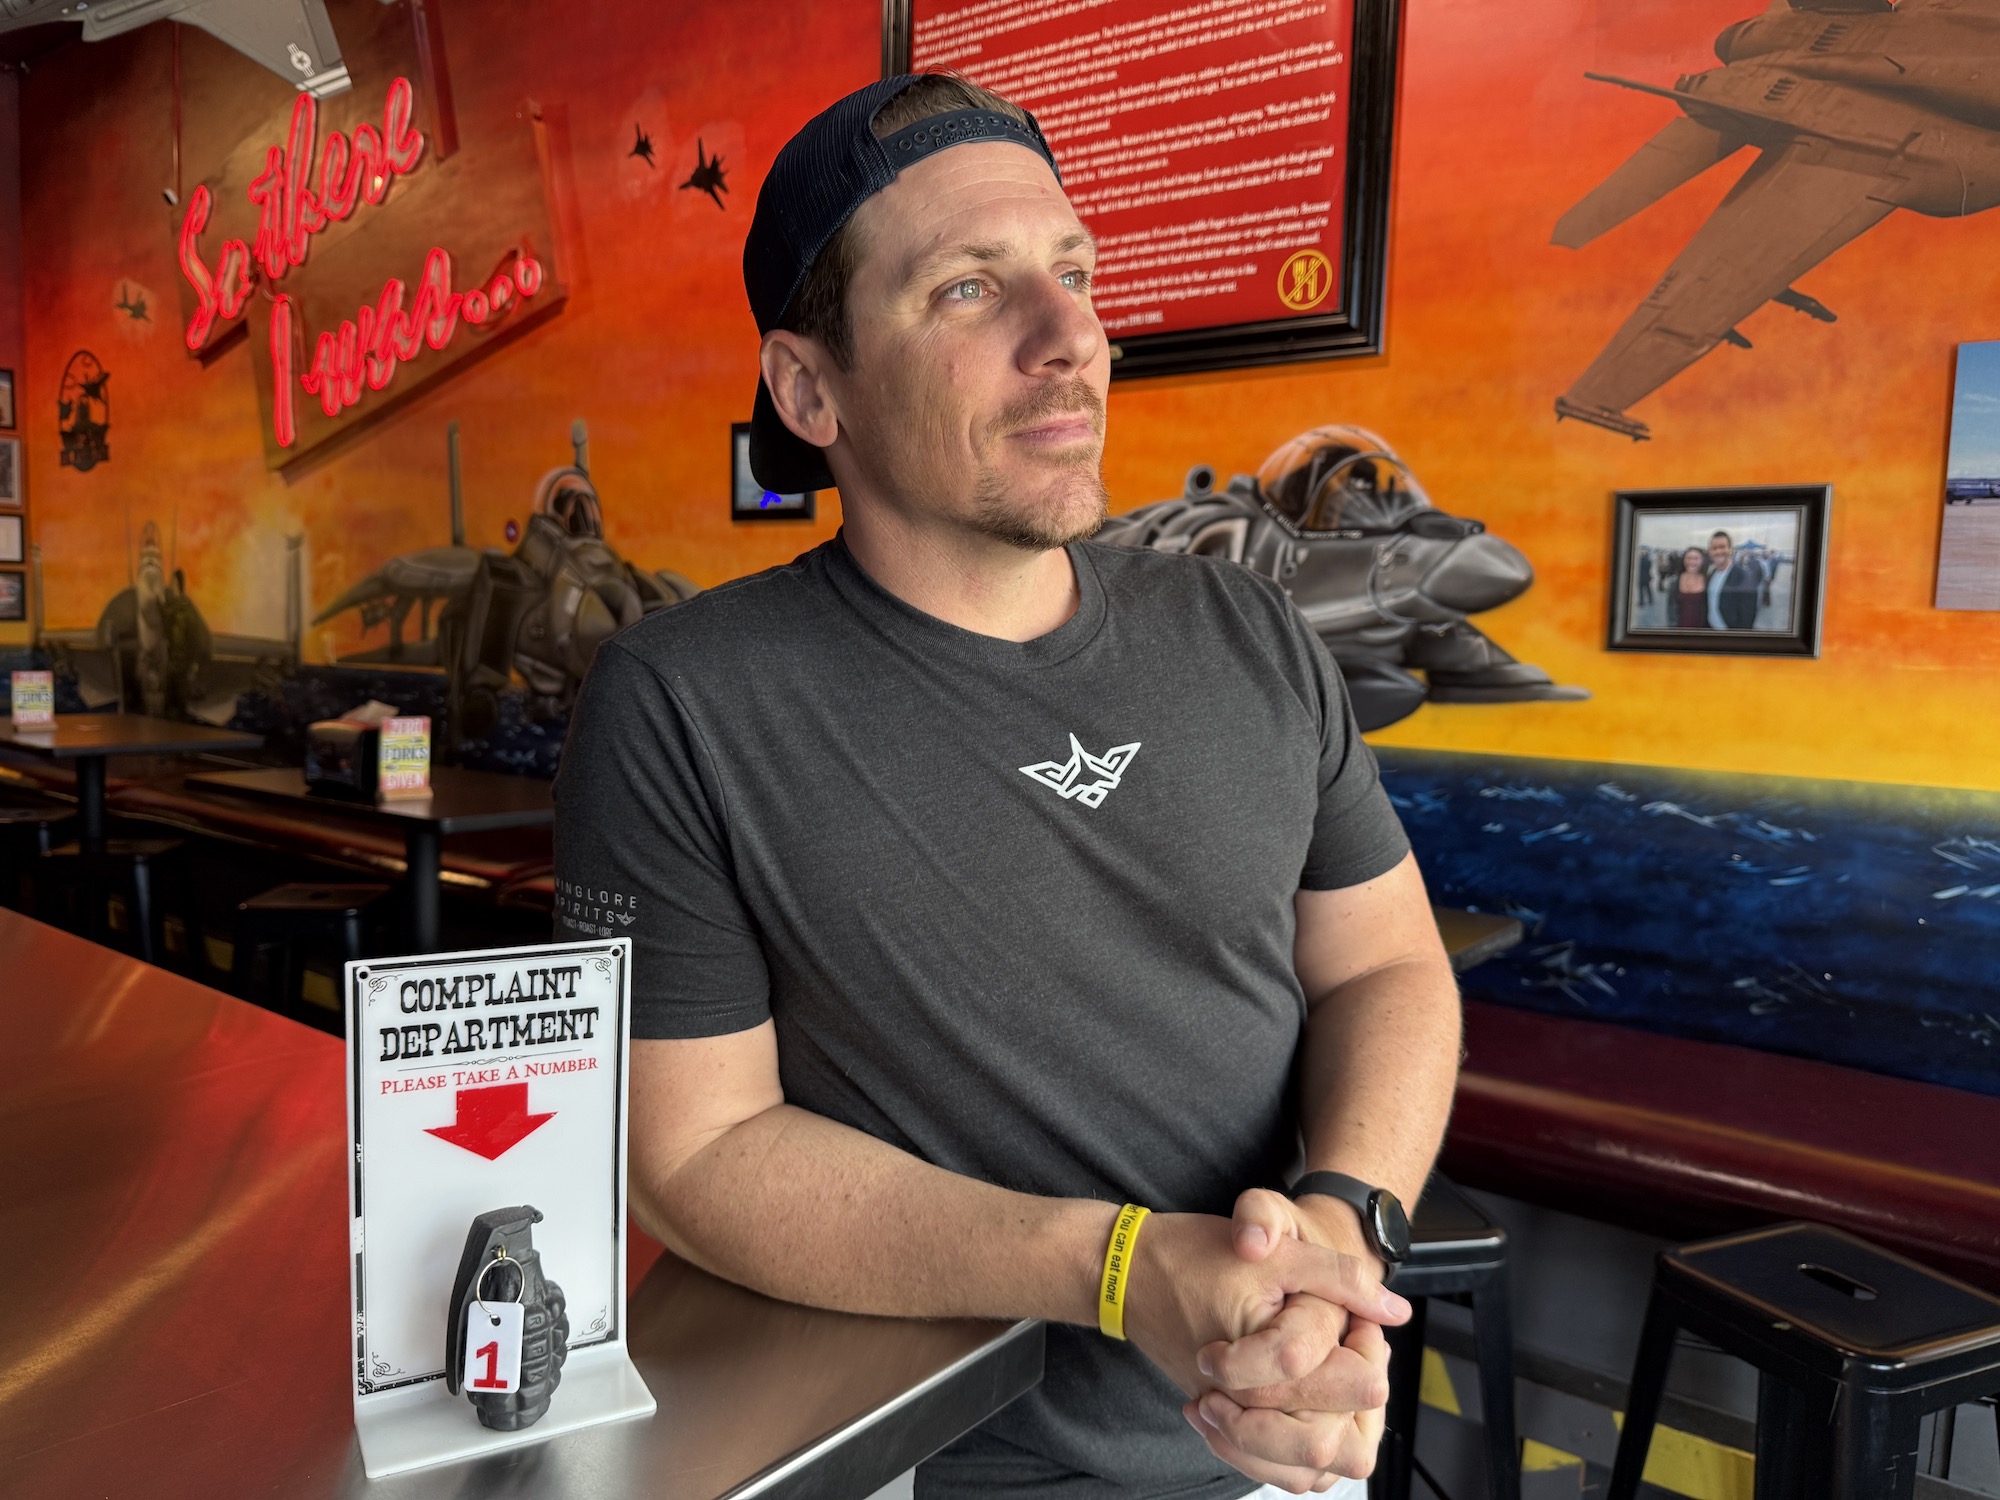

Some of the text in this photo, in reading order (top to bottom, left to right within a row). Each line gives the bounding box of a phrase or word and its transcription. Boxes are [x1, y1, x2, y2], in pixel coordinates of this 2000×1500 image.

[935, 127, 989, 147] RICHARDSON
[390, 718, 424, 736] ZERO
[380, 747, 429, 760] FORKS
[385, 773, 425, 789] GIVEN
[399, 965, 583, 1015] COMPLAINT
[380, 1006, 600, 1062] DEPARTMENT
[380, 1056, 599, 1095] PLEASE TAKE A NUMBER
[1120, 1214, 1137, 1231] You
[1114, 1232, 1127, 1252] can
[1109, 1255, 1122, 1273] eat
[1104, 1274, 1119, 1306] more!
[473, 1341, 508, 1389] 1
